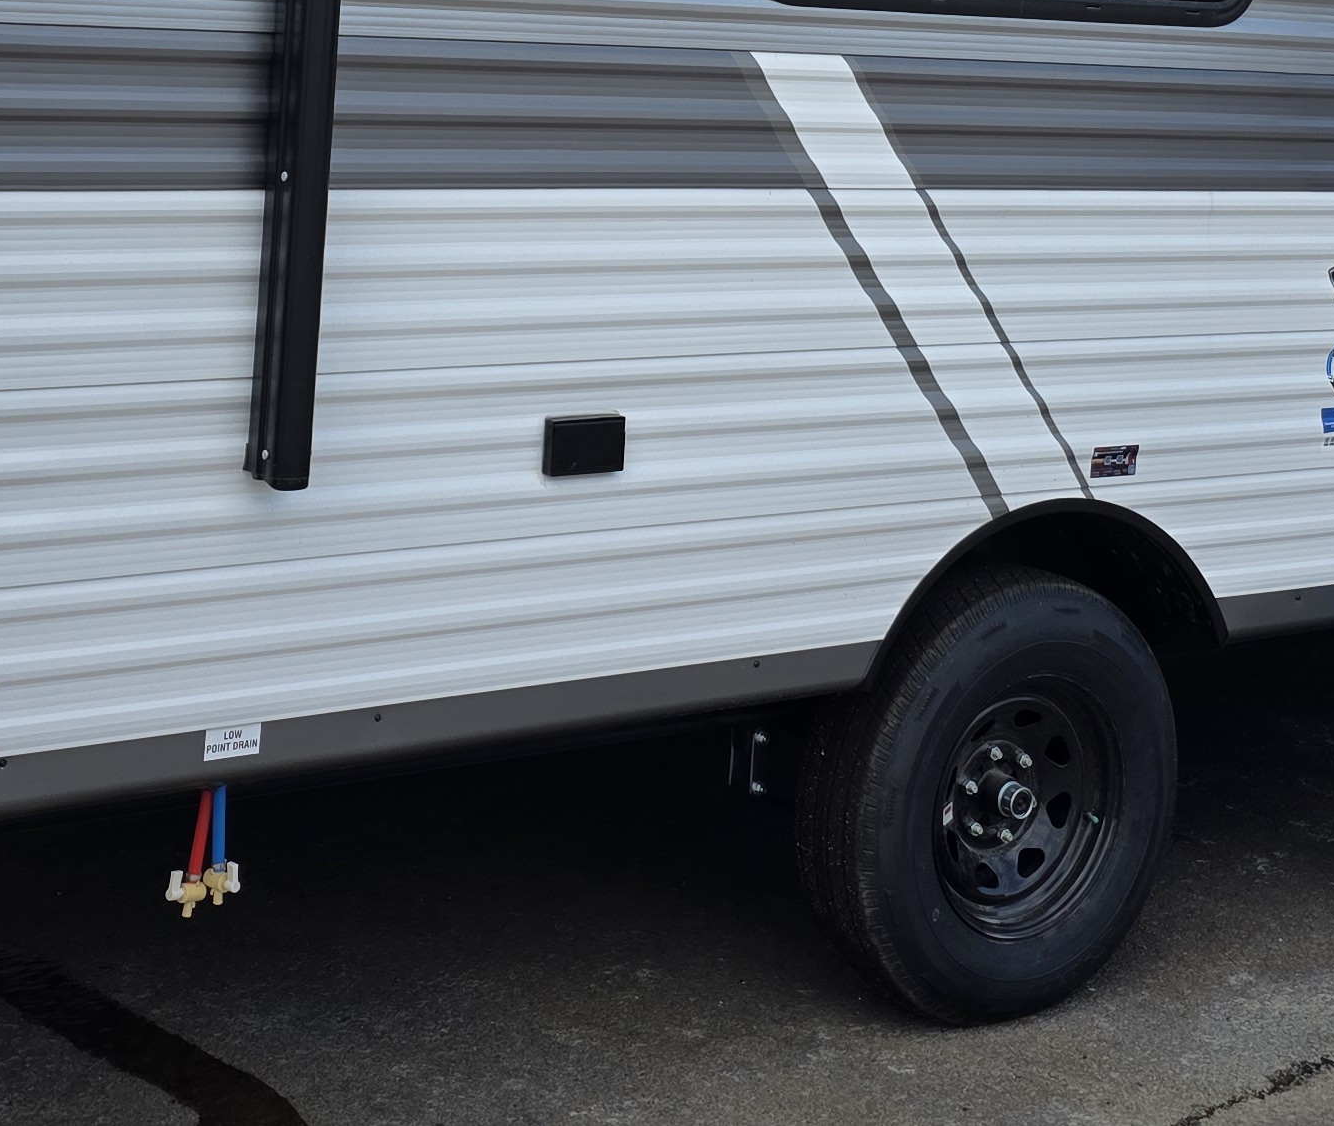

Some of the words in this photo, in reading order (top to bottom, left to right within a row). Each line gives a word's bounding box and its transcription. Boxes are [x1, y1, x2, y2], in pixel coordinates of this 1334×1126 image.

[223, 729, 243, 741] LOW
[206, 742, 232, 755] POINT
[232, 738, 258, 751] DRAIN
